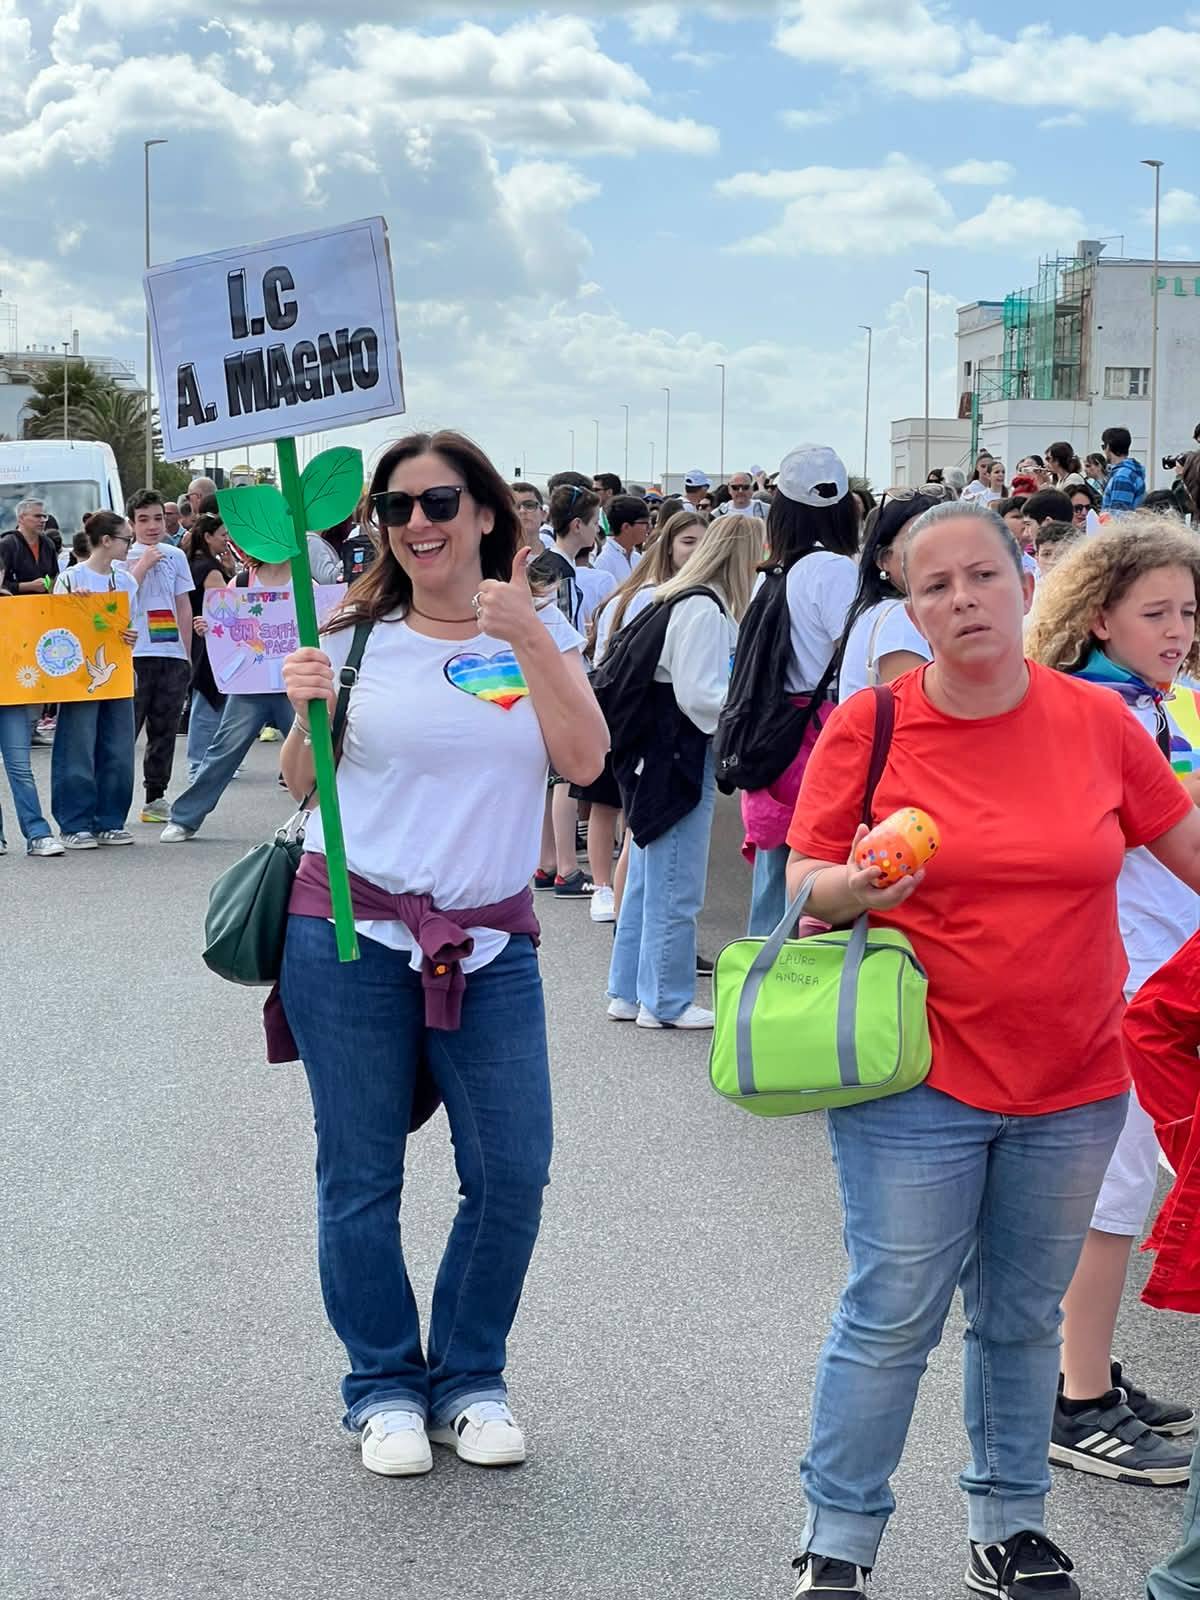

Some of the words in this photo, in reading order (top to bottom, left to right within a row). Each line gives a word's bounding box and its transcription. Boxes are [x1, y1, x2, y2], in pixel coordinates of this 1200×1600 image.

[227, 265, 298, 339] I.C
[177, 362, 218, 429] A.
[223, 327, 380, 417] MAGNO
[230, 623, 254, 641] UN
[265, 639, 297, 655] PACE
[776, 972, 819, 985] ANDREA
